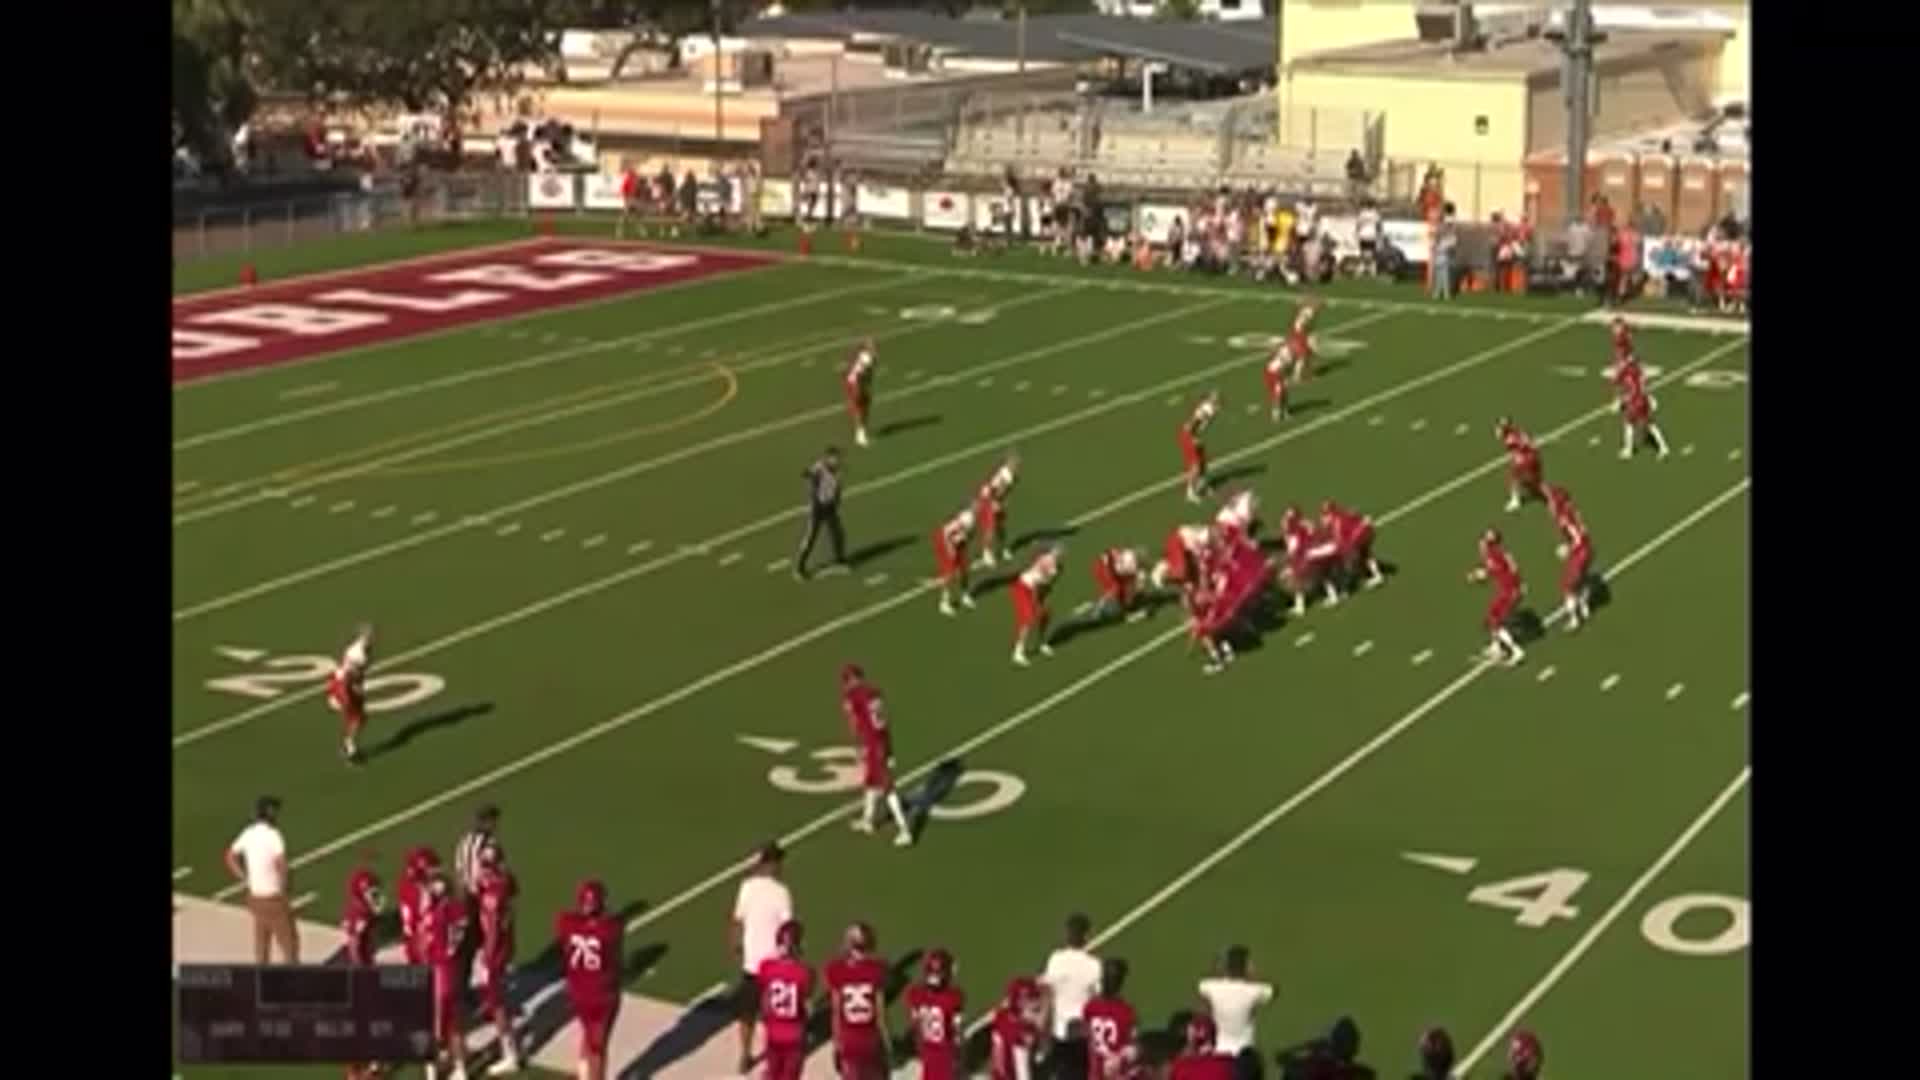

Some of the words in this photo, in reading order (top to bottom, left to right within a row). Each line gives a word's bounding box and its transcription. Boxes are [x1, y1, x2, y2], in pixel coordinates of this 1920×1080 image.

[768, 746, 1027, 820] 30
[1466, 867, 1750, 955] 40
[569, 933, 602, 970] 76
[770, 979, 798, 1018] 21
[841, 983, 874, 1023] 25
